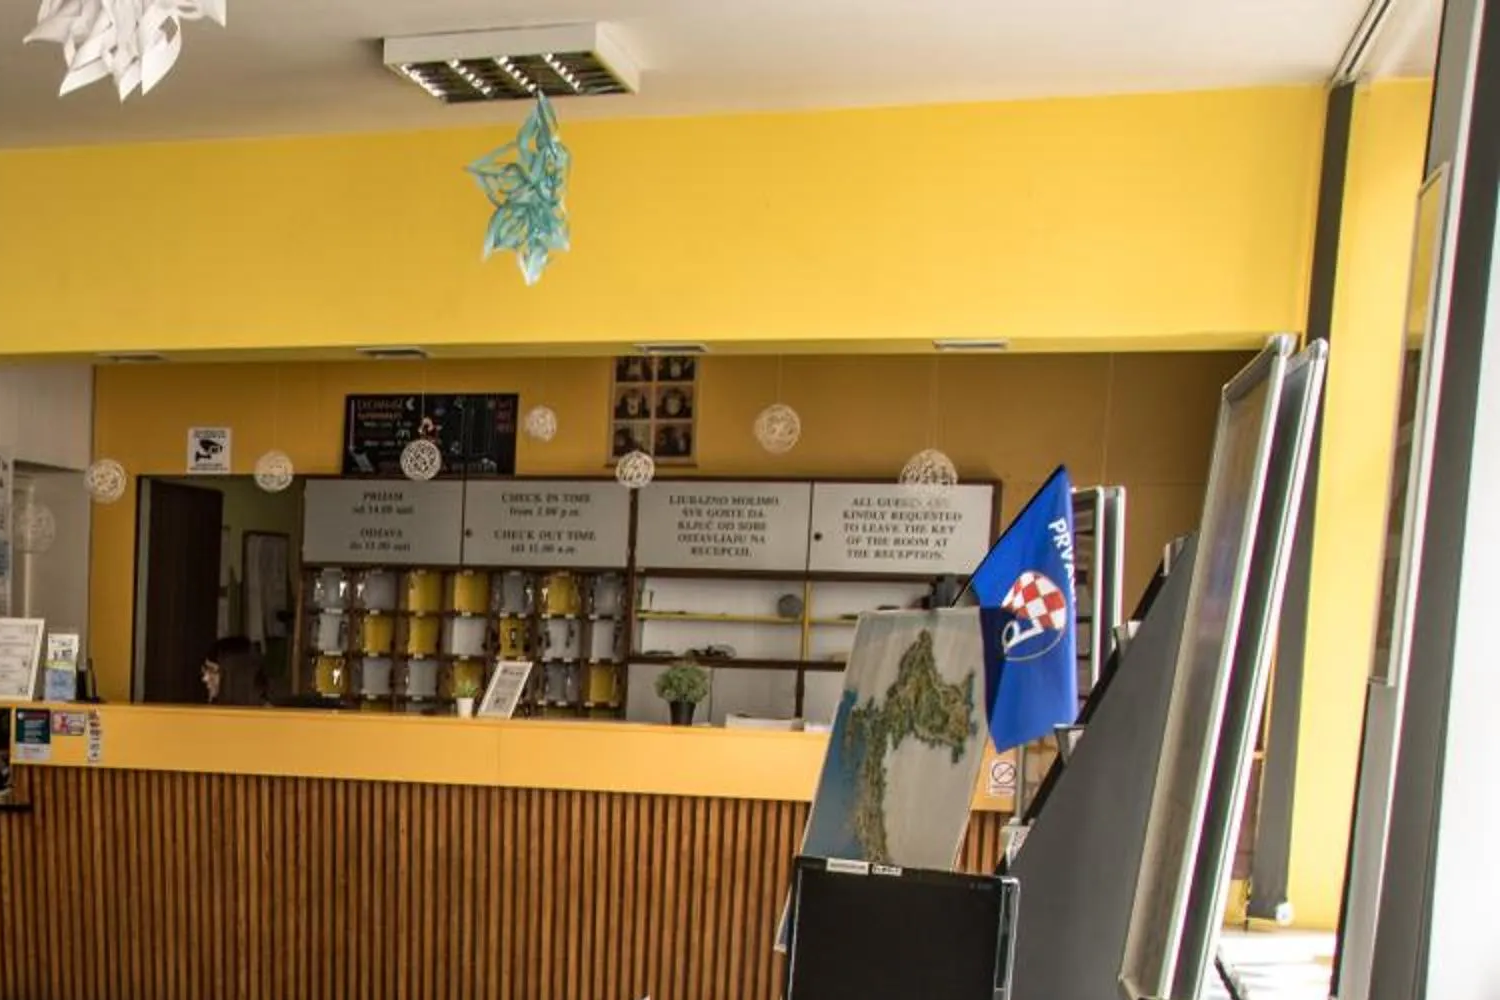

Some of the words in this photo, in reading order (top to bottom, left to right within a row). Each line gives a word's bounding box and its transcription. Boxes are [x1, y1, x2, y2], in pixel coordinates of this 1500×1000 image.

[501, 493, 542, 503] CHECK
[545, 493, 559, 503] IN
[563, 493, 590, 503] TIME
[669, 495, 728, 505] LJUBAZNO
[732, 496, 779, 506] MOLIMO
[852, 498, 873, 507] ALL
[509, 507, 533, 516] from
[682, 508, 703, 518] SVE
[707, 509, 744, 518] GOSTE
[747, 509, 764, 519] DA
[843, 511, 886, 520] KINDLY
[891, 511, 962, 521] REQUESTED
[717, 521, 735, 531] OD
[738, 521, 766, 531] SOBE
[843, 523, 859, 533] TO
[862, 523, 900, 533] LEAVE
[905, 524, 928, 533] THE
[931, 524, 956, 534] KEY
[494, 529, 535, 540] CHECK
[539, 530, 563, 540] OUT
[567, 530, 596, 541] TIME
[677, 533, 747, 543] OSTAVLJAJU
[750, 534, 766, 543] NA
[846, 536, 862, 545] OF
[866, 536, 889, 545] THE
[893, 536, 929, 546] ROOM
[934, 537, 949, 546] AT
[847, 549, 869, 558] THE
[873, 549, 945, 559] RECEPTION.
